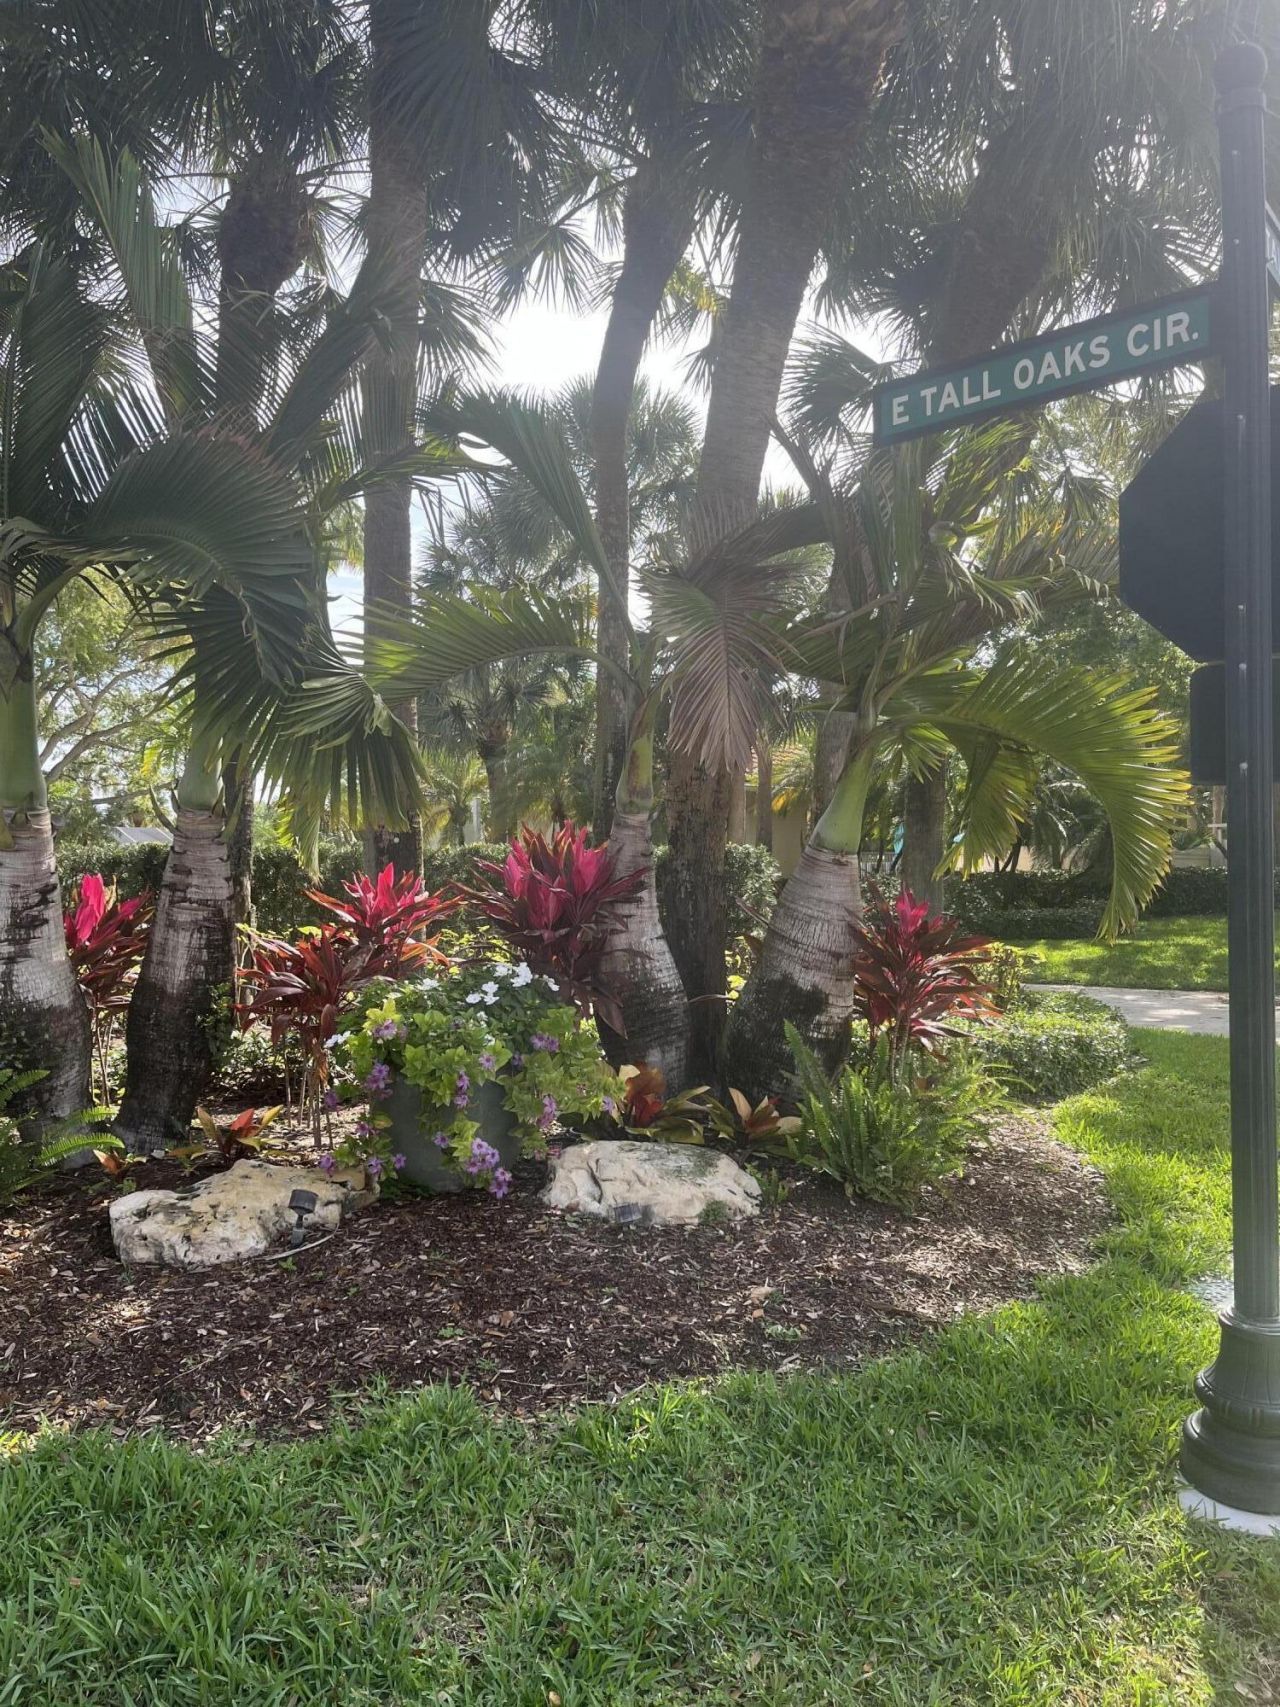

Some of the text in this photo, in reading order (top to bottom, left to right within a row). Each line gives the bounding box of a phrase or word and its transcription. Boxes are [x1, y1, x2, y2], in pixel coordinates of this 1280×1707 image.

[892, 311, 1199, 425] E TALL OAKS CIR.
